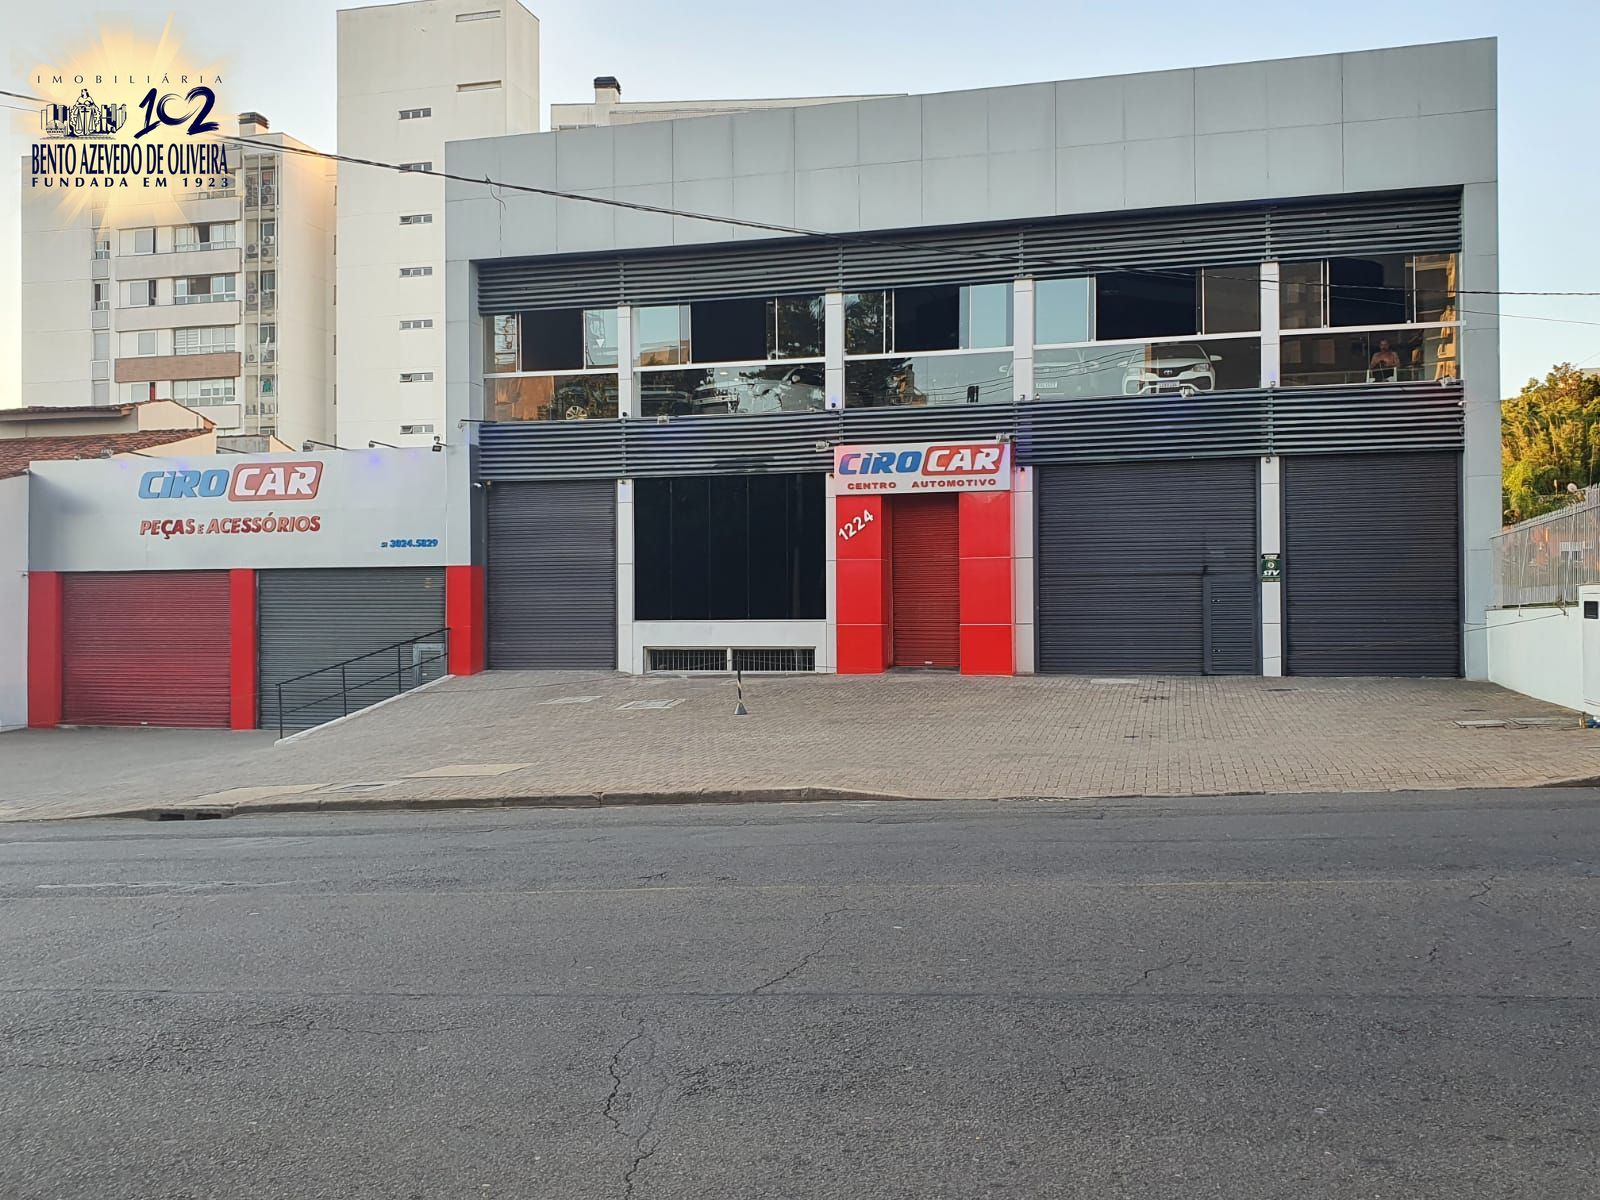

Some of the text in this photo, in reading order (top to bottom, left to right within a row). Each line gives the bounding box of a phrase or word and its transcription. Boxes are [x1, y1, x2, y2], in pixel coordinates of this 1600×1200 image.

[925, 447, 1000, 473] CAR
[233, 465, 319, 498] CAR
[847, 478, 997, 490] CENTRO AUTOMOTIVO
[139, 518, 196, 539] PEÇAS
[205, 512, 321, 535] ACESSÓRIOS
[838, 509, 875, 541] 1224
